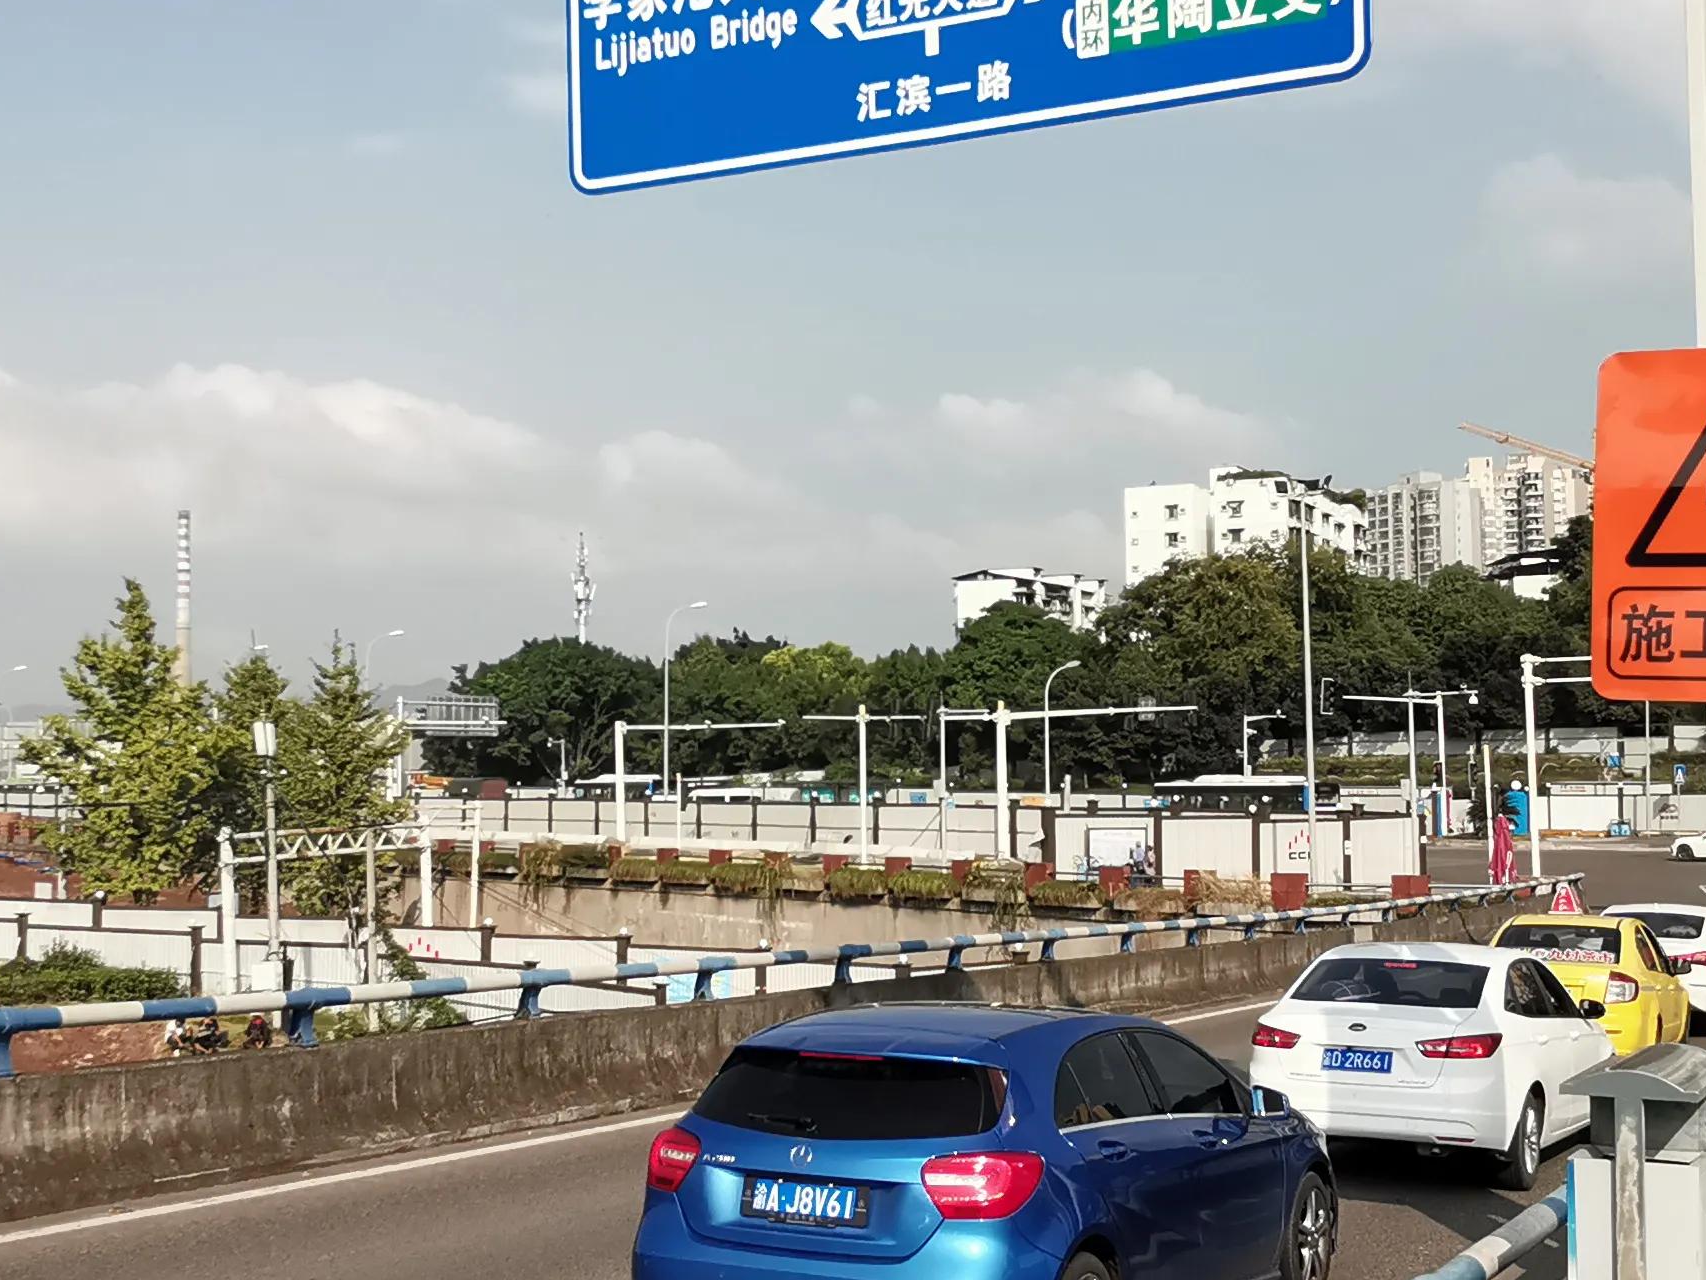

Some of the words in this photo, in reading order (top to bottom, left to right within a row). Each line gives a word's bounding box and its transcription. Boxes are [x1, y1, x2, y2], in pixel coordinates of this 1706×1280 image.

[594, 24, 696, 77] Lijiatuo
[710, 6, 798, 51] Bridge
[855, 59, 1013, 123] 汇滨一路
